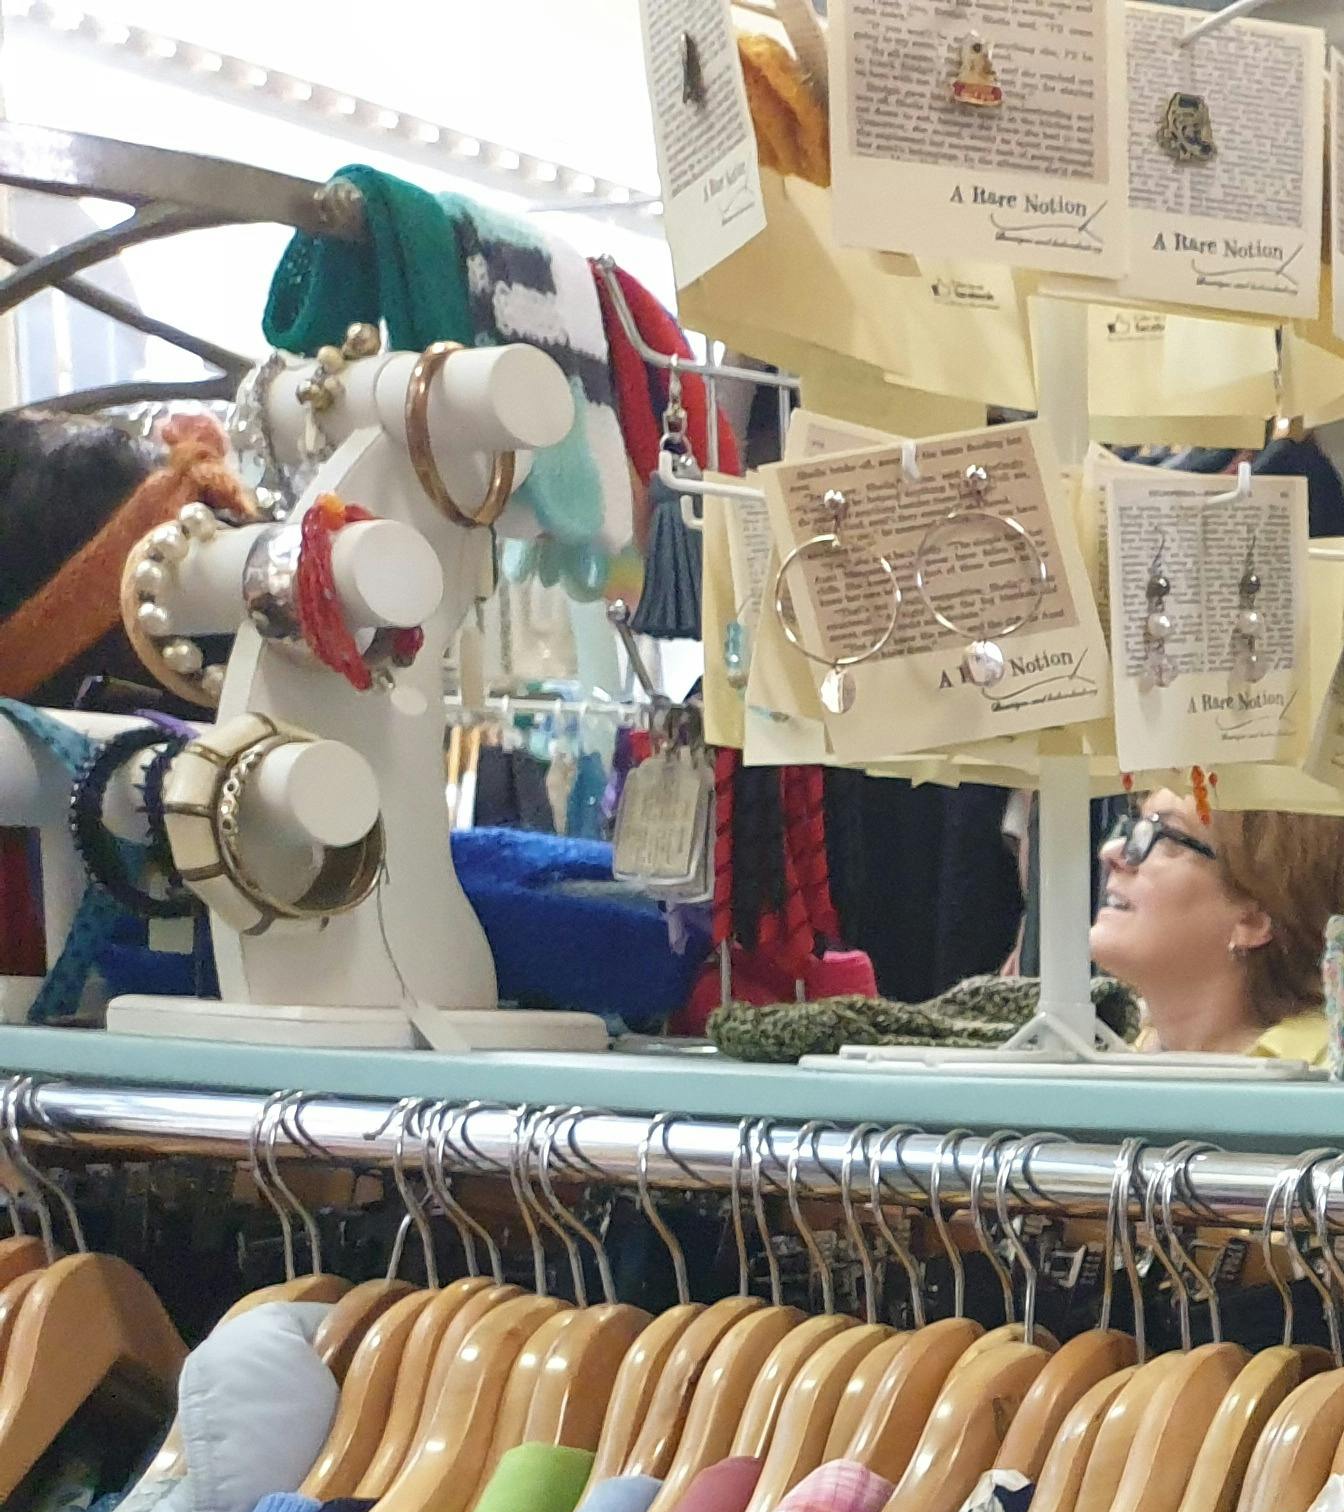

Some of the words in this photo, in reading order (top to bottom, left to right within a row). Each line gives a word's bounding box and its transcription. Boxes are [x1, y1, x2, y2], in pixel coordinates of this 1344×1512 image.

[950, 185, 963, 204] A
[972, 186, 1018, 209] Rare
[1024, 194, 1087, 218] Notion
[1152, 232, 1167, 251] A
[1173, 232, 1218, 256] Rare
[1222, 239, 1284, 261] Notion
[939, 669, 953, 690] A
[1009, 650, 1074, 677] Notion
[1187, 697, 1198, 715] A
[1200, 693, 1235, 713] Rare
[1237, 691, 1286, 712] Notion
